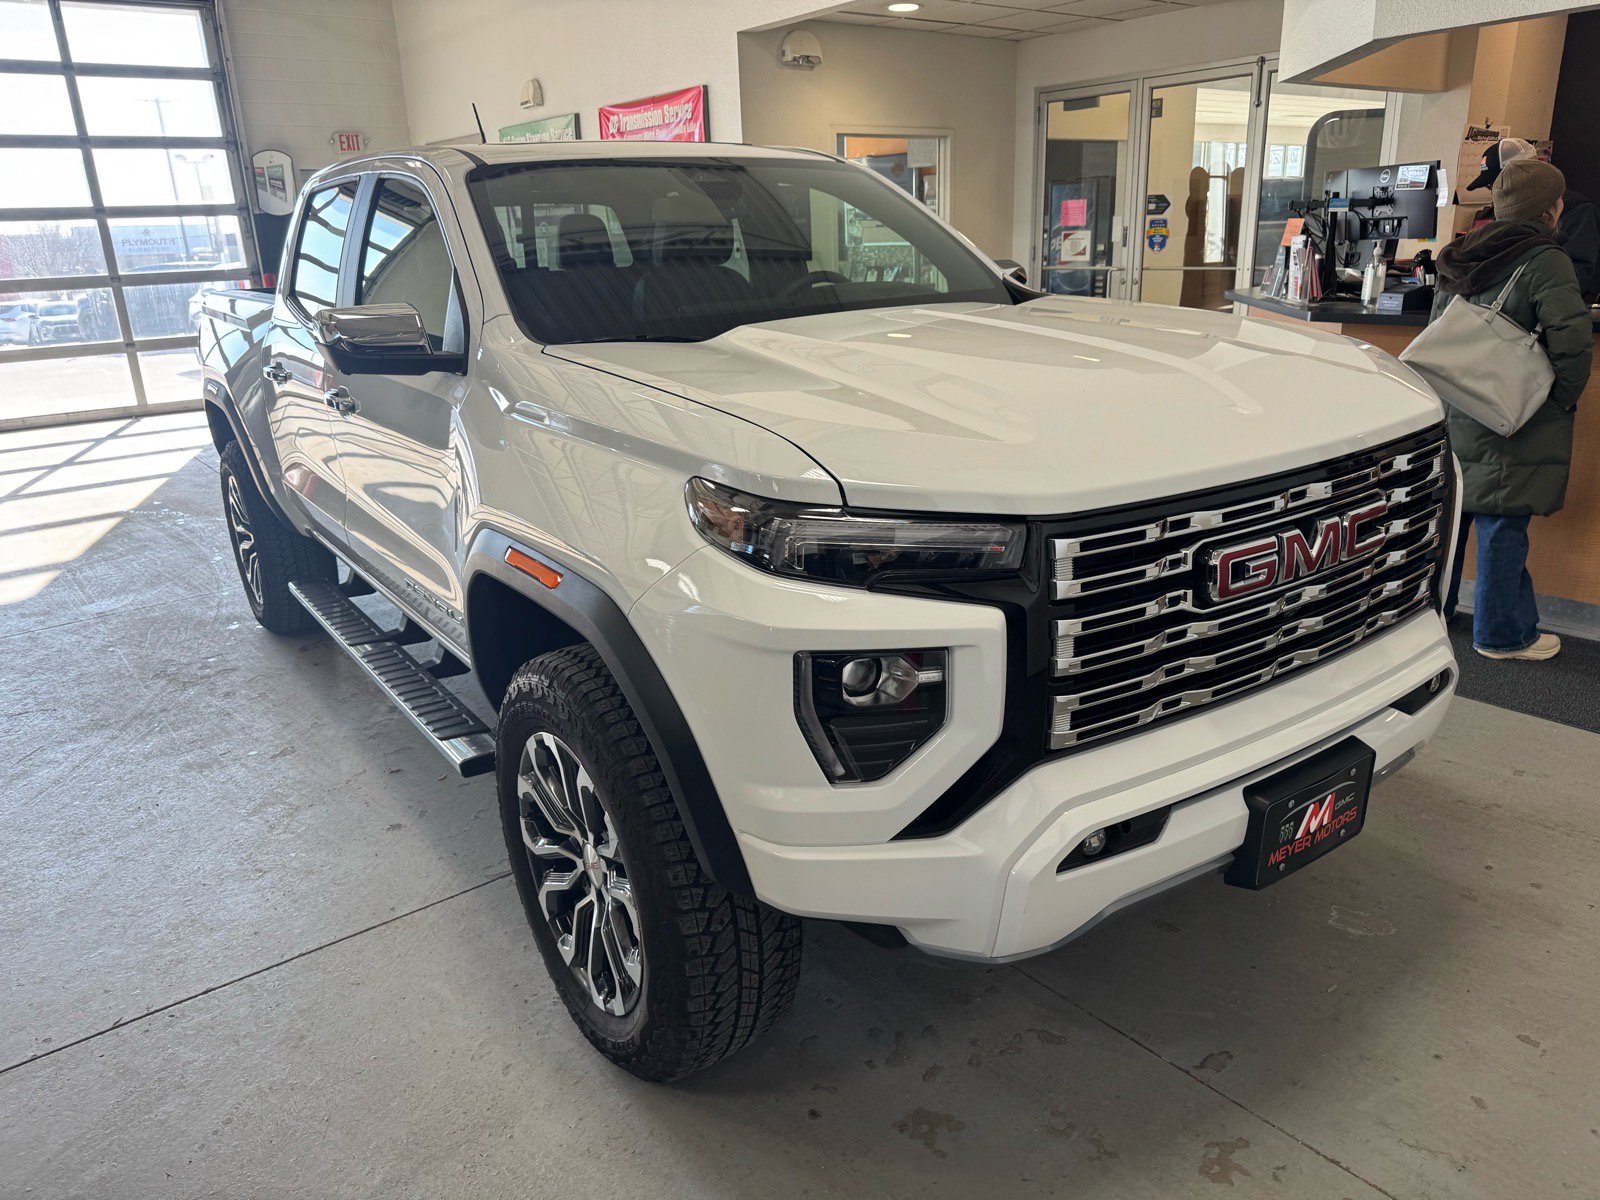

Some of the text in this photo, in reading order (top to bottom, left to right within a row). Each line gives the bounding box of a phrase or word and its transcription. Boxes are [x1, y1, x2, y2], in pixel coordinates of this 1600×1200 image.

[619, 107, 663, 132] Transmission
[663, 100, 693, 124] Service
[338, 134, 361, 152] EXIT
[121, 238, 176, 247] PLYMOUTH
[1211, 501, 1388, 602] GMC
[1335, 792, 1355, 810] GMC
[1267, 806, 1358, 867] MEYER MOTORS
